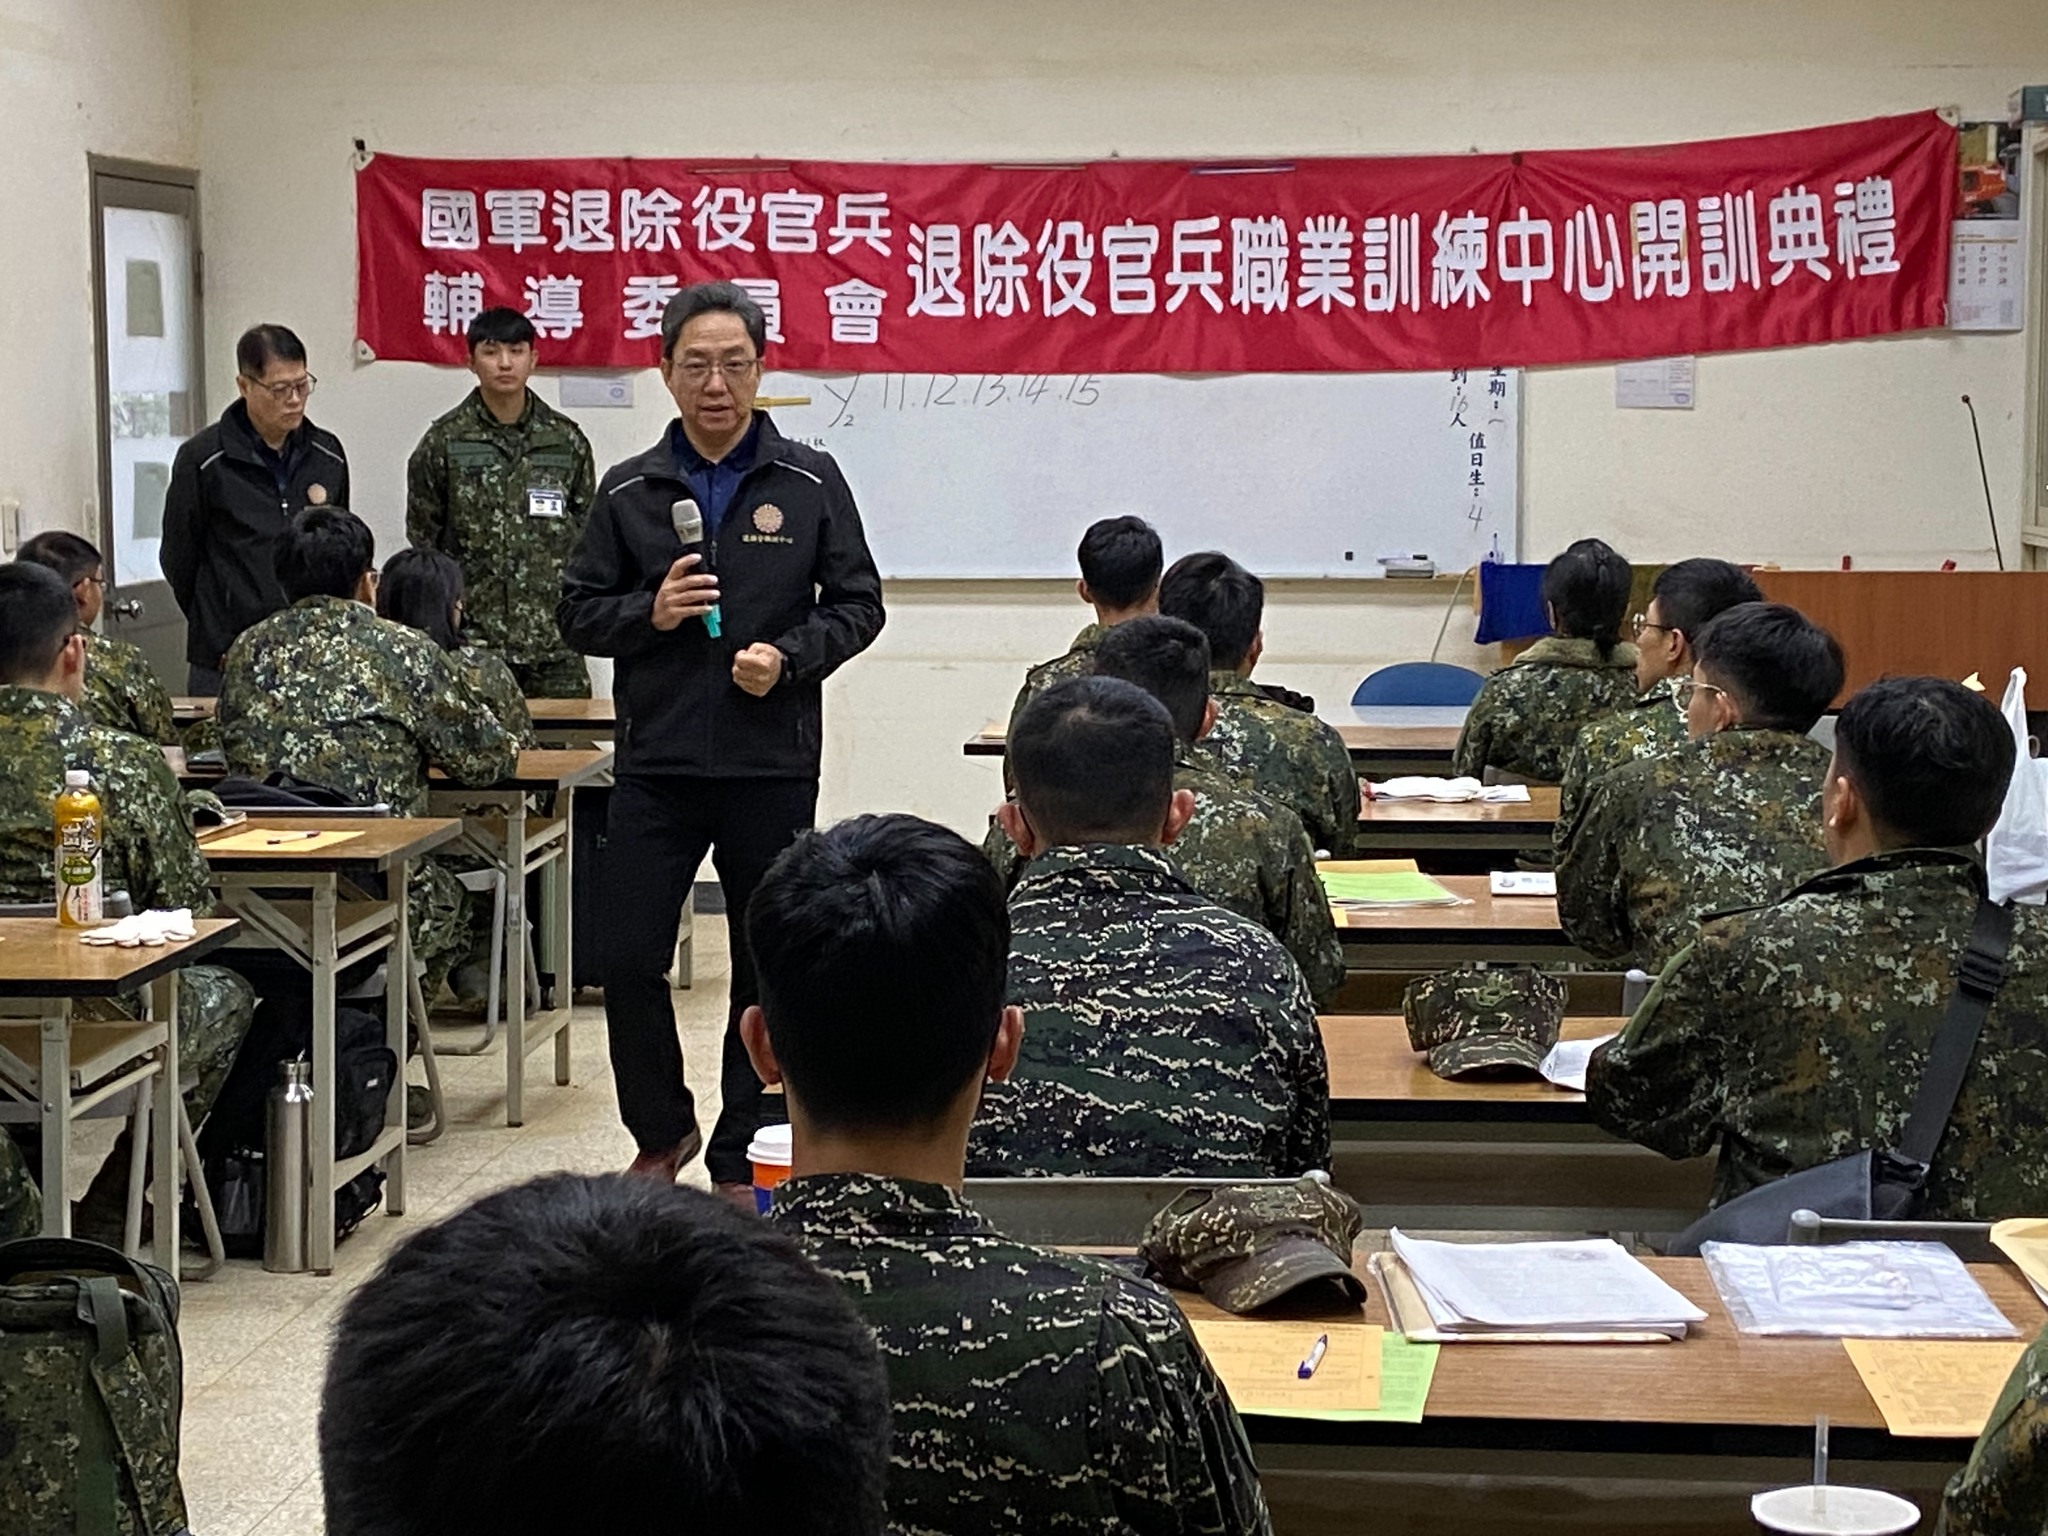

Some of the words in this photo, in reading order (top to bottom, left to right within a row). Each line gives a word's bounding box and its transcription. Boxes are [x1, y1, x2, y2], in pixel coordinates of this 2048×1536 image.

[421, 185, 892, 257] 國軍退除役官兵
[906, 175, 1901, 318] 退除役官兵職業訓練中心開訓典禮
